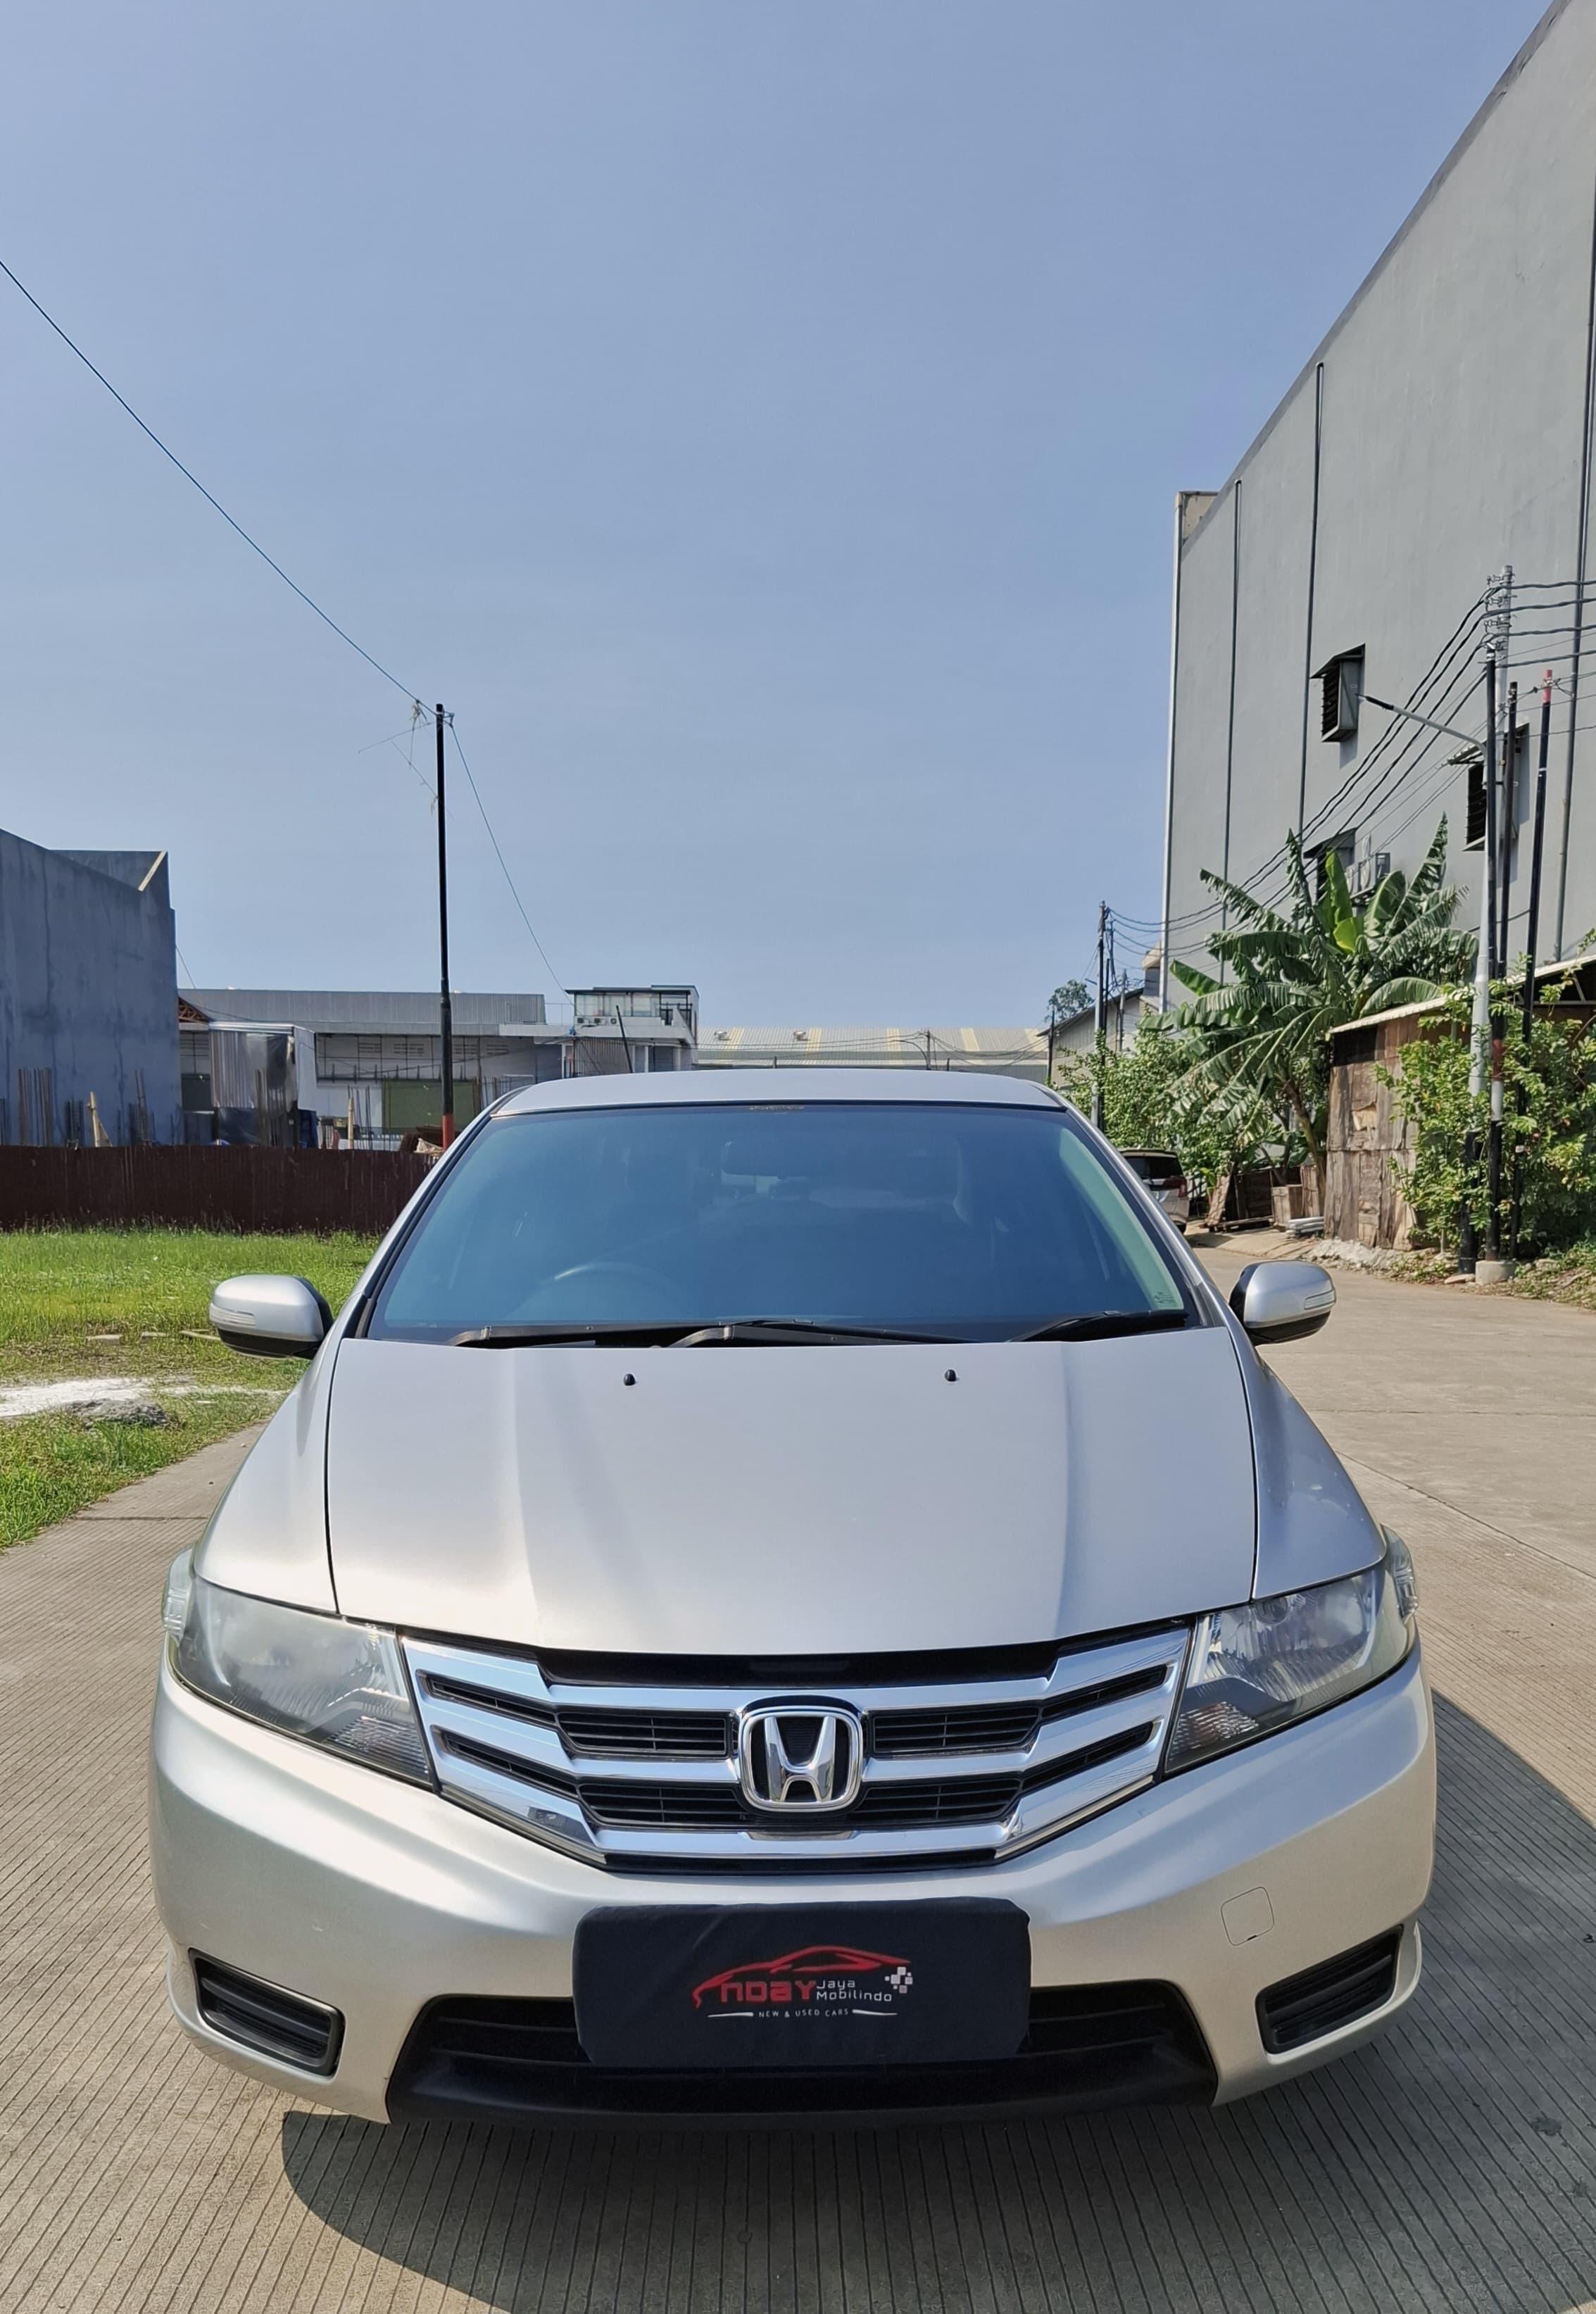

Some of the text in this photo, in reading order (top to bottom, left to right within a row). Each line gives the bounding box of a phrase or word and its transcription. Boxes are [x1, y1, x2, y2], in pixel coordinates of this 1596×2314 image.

[816, 1980, 855, 1990] Jaya
[816, 1989, 892, 2001] Mobilindo
[824, 2008, 848, 2017] CARS
